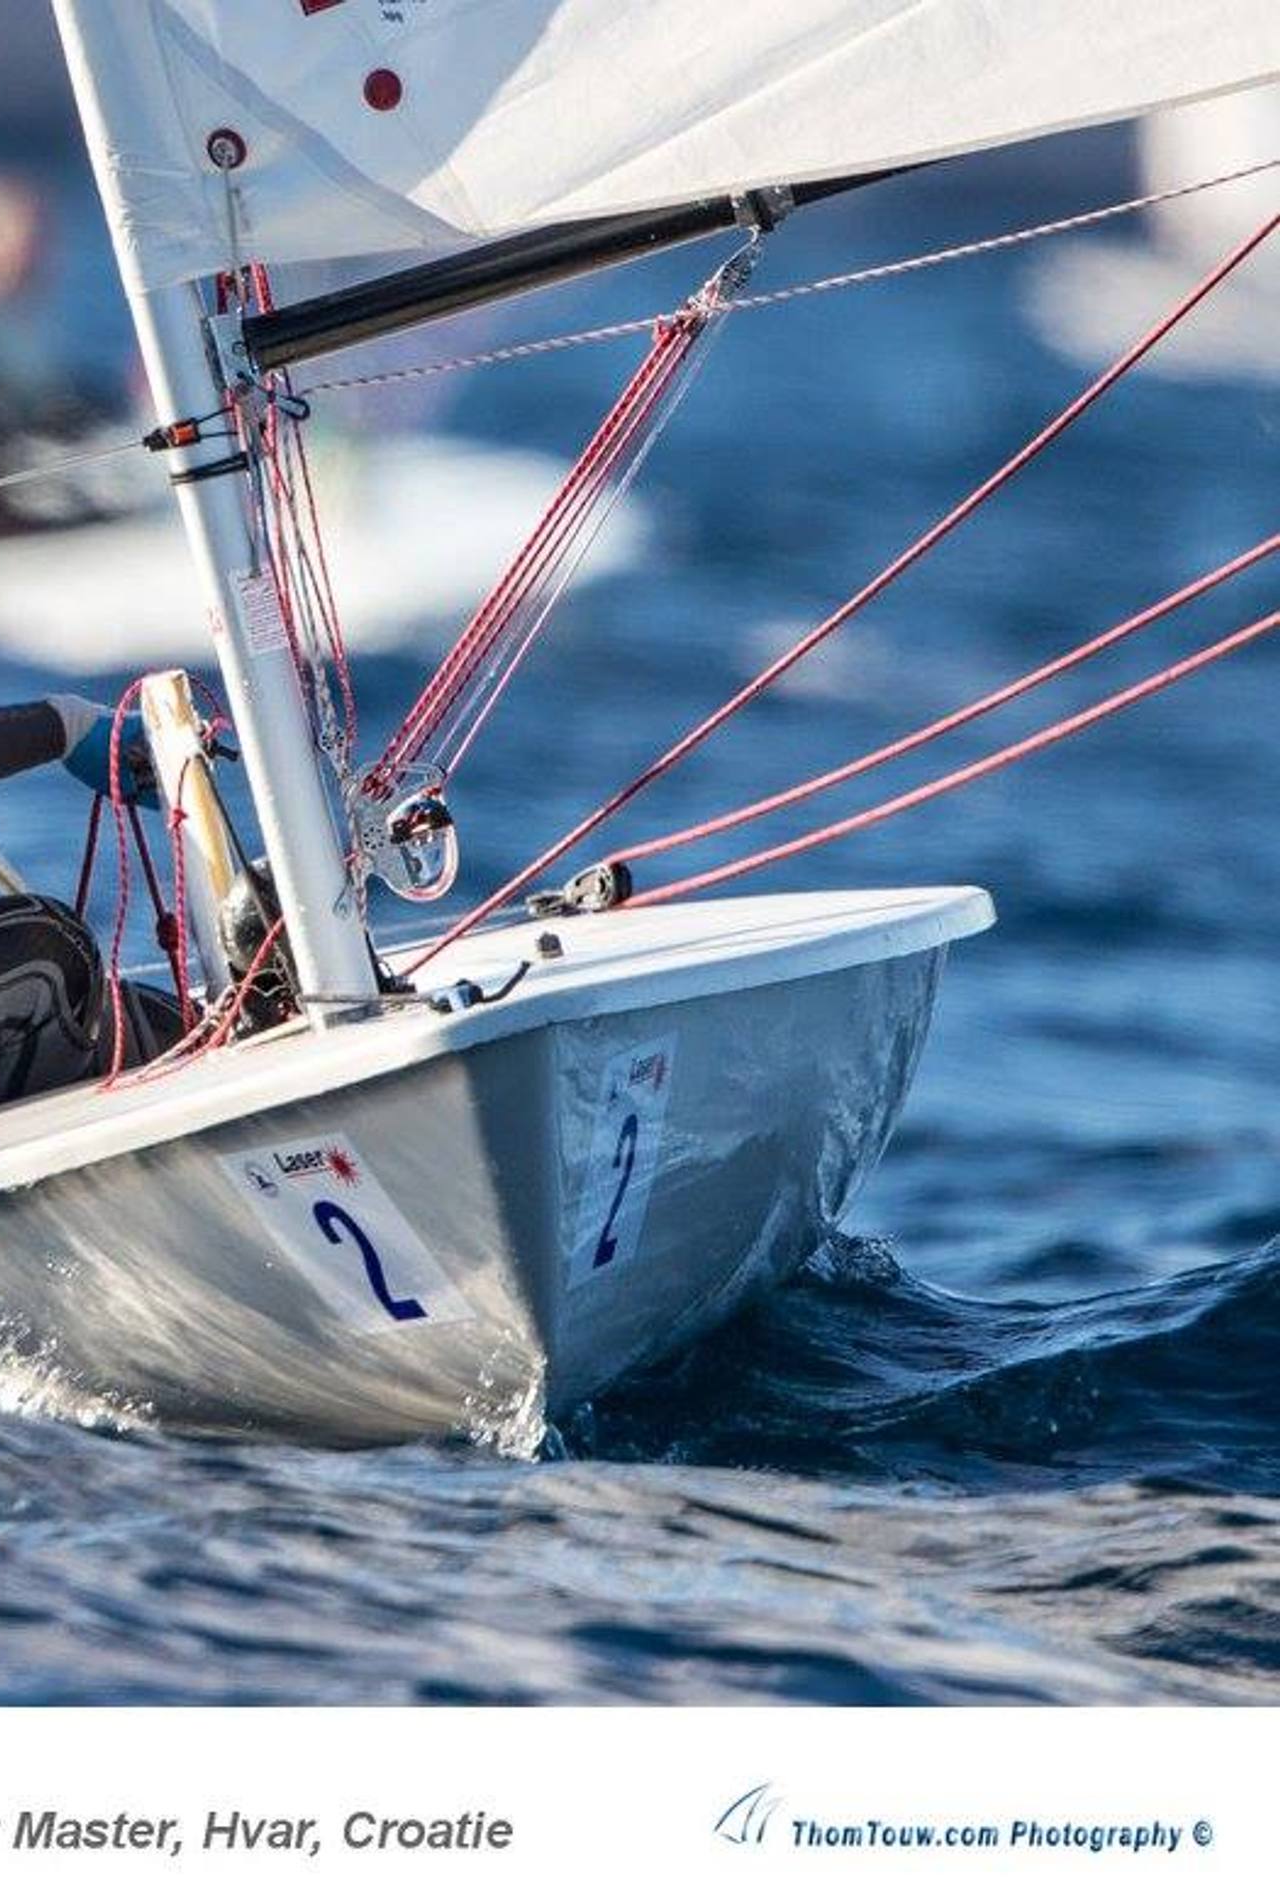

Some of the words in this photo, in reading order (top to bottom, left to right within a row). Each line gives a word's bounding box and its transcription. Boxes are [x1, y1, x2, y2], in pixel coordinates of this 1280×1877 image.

[274, 1150, 326, 1173] Laser
[592, 1114, 638, 1269] 2
[313, 1200, 428, 1320] 2
